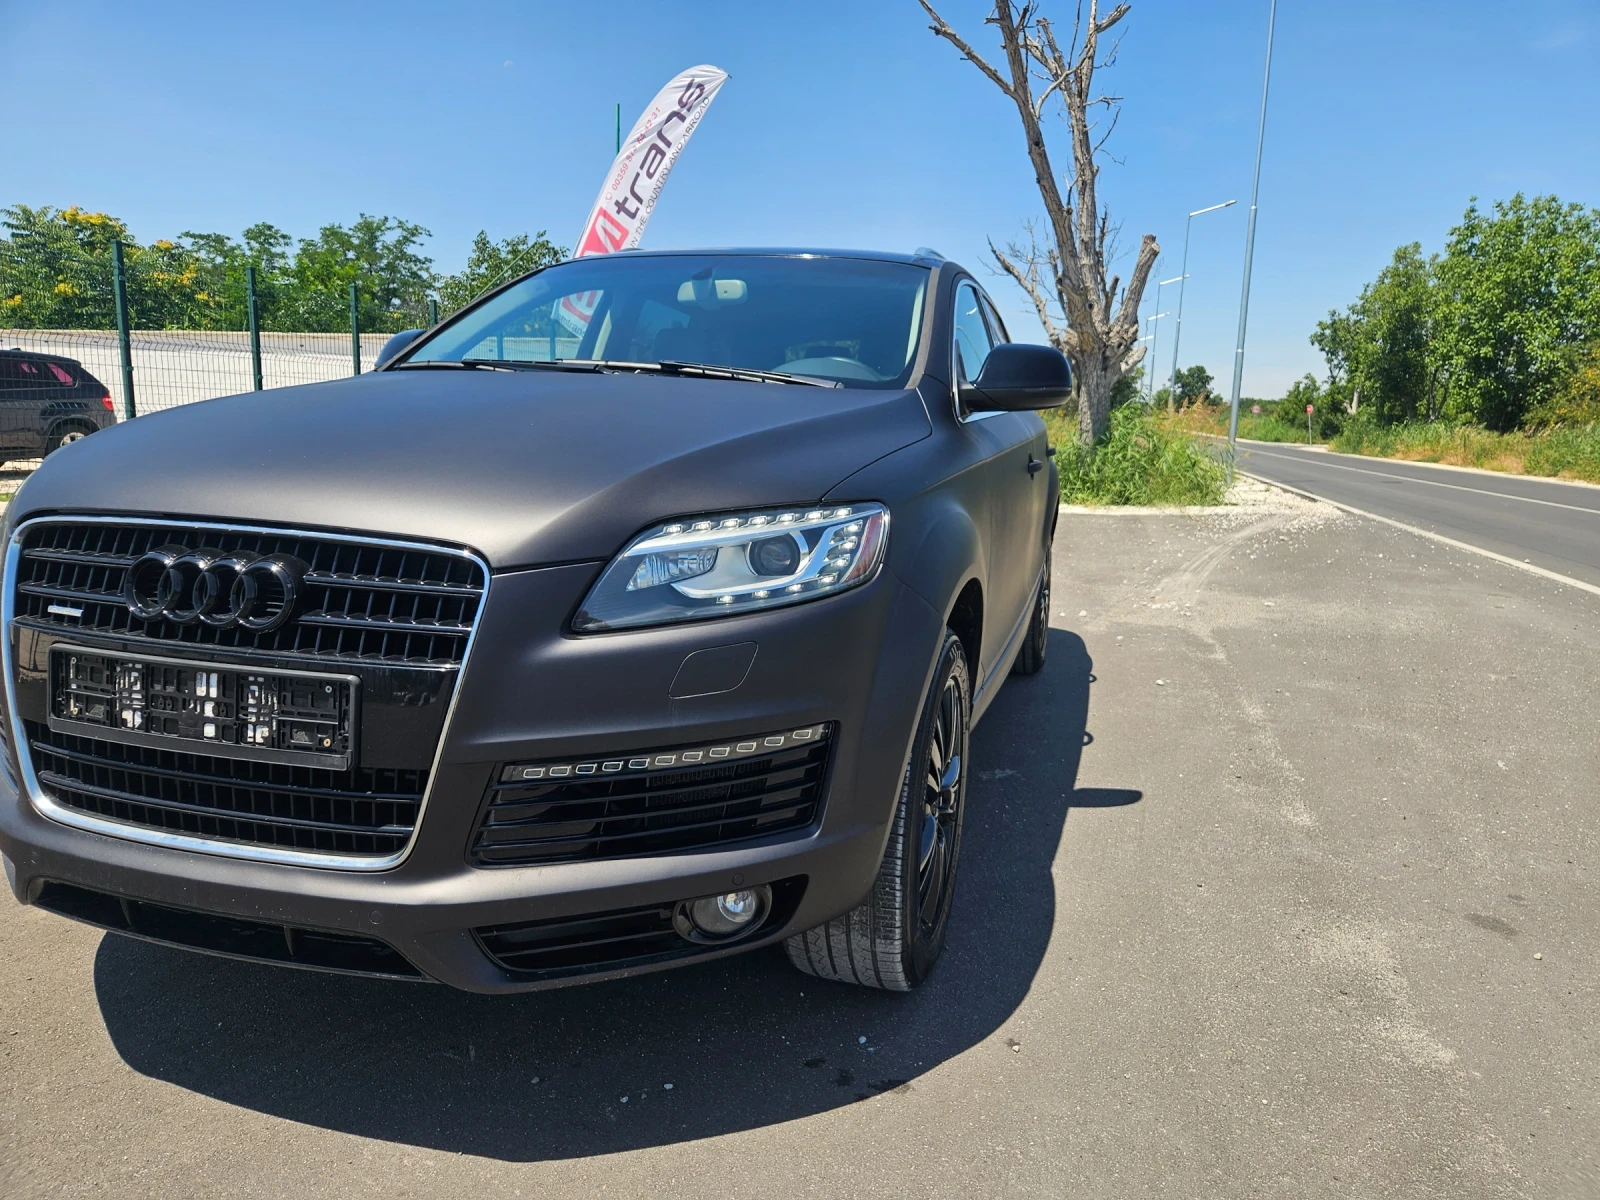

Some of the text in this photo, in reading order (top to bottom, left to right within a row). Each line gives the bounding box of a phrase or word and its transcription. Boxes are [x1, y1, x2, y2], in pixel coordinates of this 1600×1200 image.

[612, 163, 628, 190] 00359
[636, 215, 647, 235] THE
[646, 163, 670, 214] COUNTRY
[669, 142, 683, 165] AND
[683, 97, 709, 142] ABROAD
